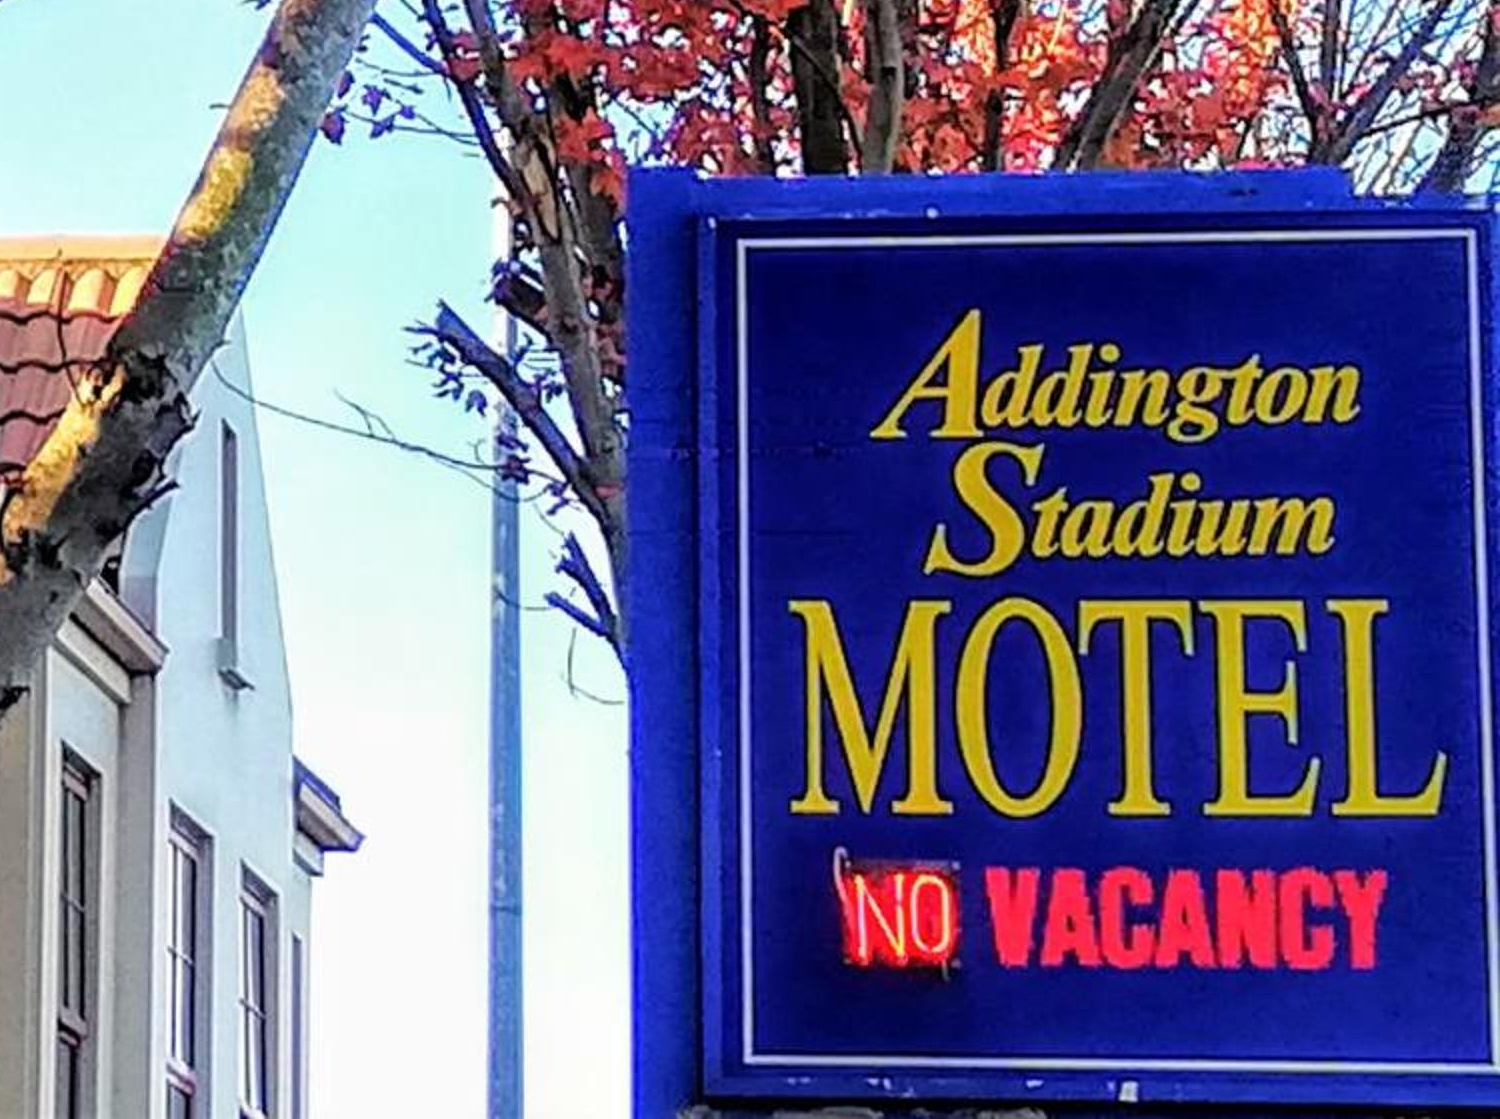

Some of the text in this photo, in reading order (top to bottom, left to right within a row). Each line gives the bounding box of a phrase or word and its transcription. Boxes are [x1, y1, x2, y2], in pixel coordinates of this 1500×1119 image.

[870, 308, 1361, 444] Addington
[923, 442, 1336, 576] Stadium
[789, 597, 1448, 819] MOTEL
[852, 866, 1389, 971] NO VACANCY
